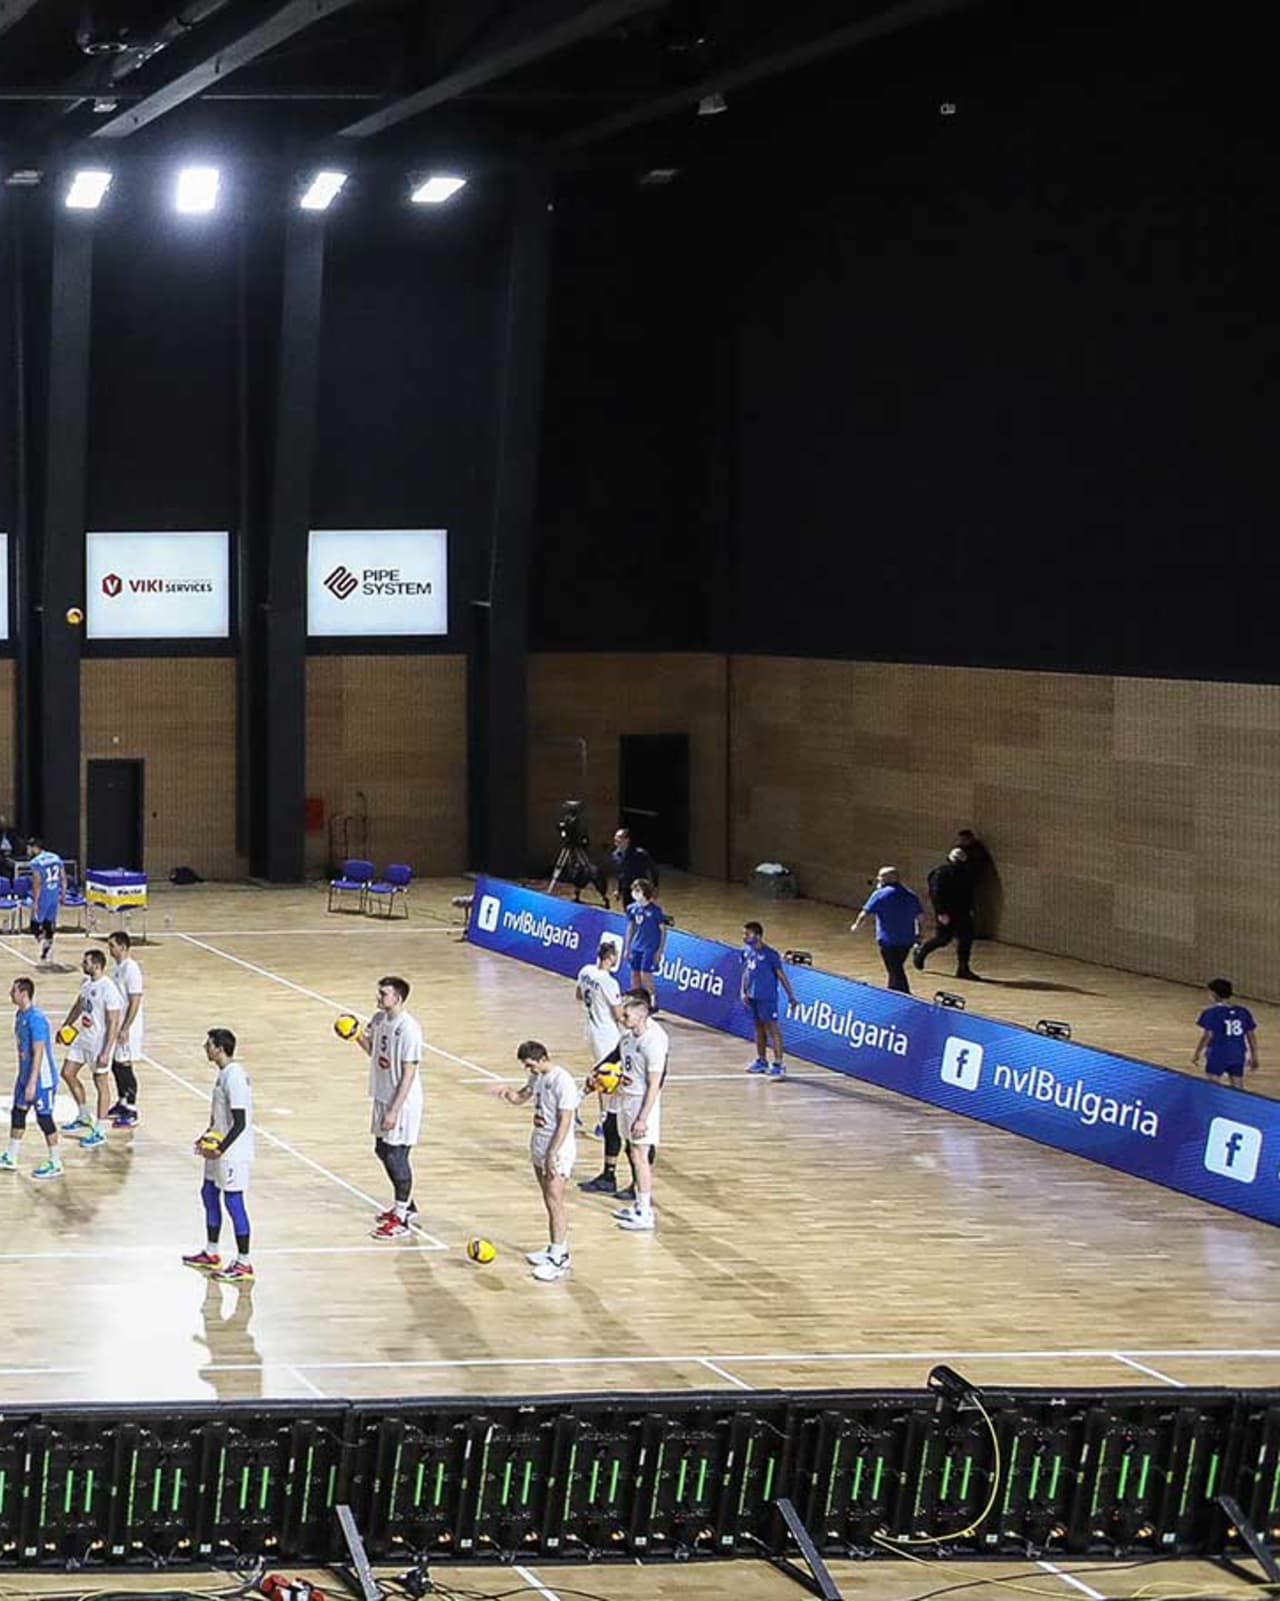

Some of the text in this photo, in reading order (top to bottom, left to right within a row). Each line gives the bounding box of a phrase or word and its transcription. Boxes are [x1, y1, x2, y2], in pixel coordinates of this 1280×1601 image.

[362, 569, 401, 581] PIPE
[128, 578, 163, 592] VIKI
[165, 582, 213, 592] SERVICES
[362, 581, 432, 595] SYSTEM
[503, 909, 580, 950] nvlBulgaria
[1223, 1019, 1244, 1037] 18
[993, 1065, 1159, 1138] nvlBulgaria
